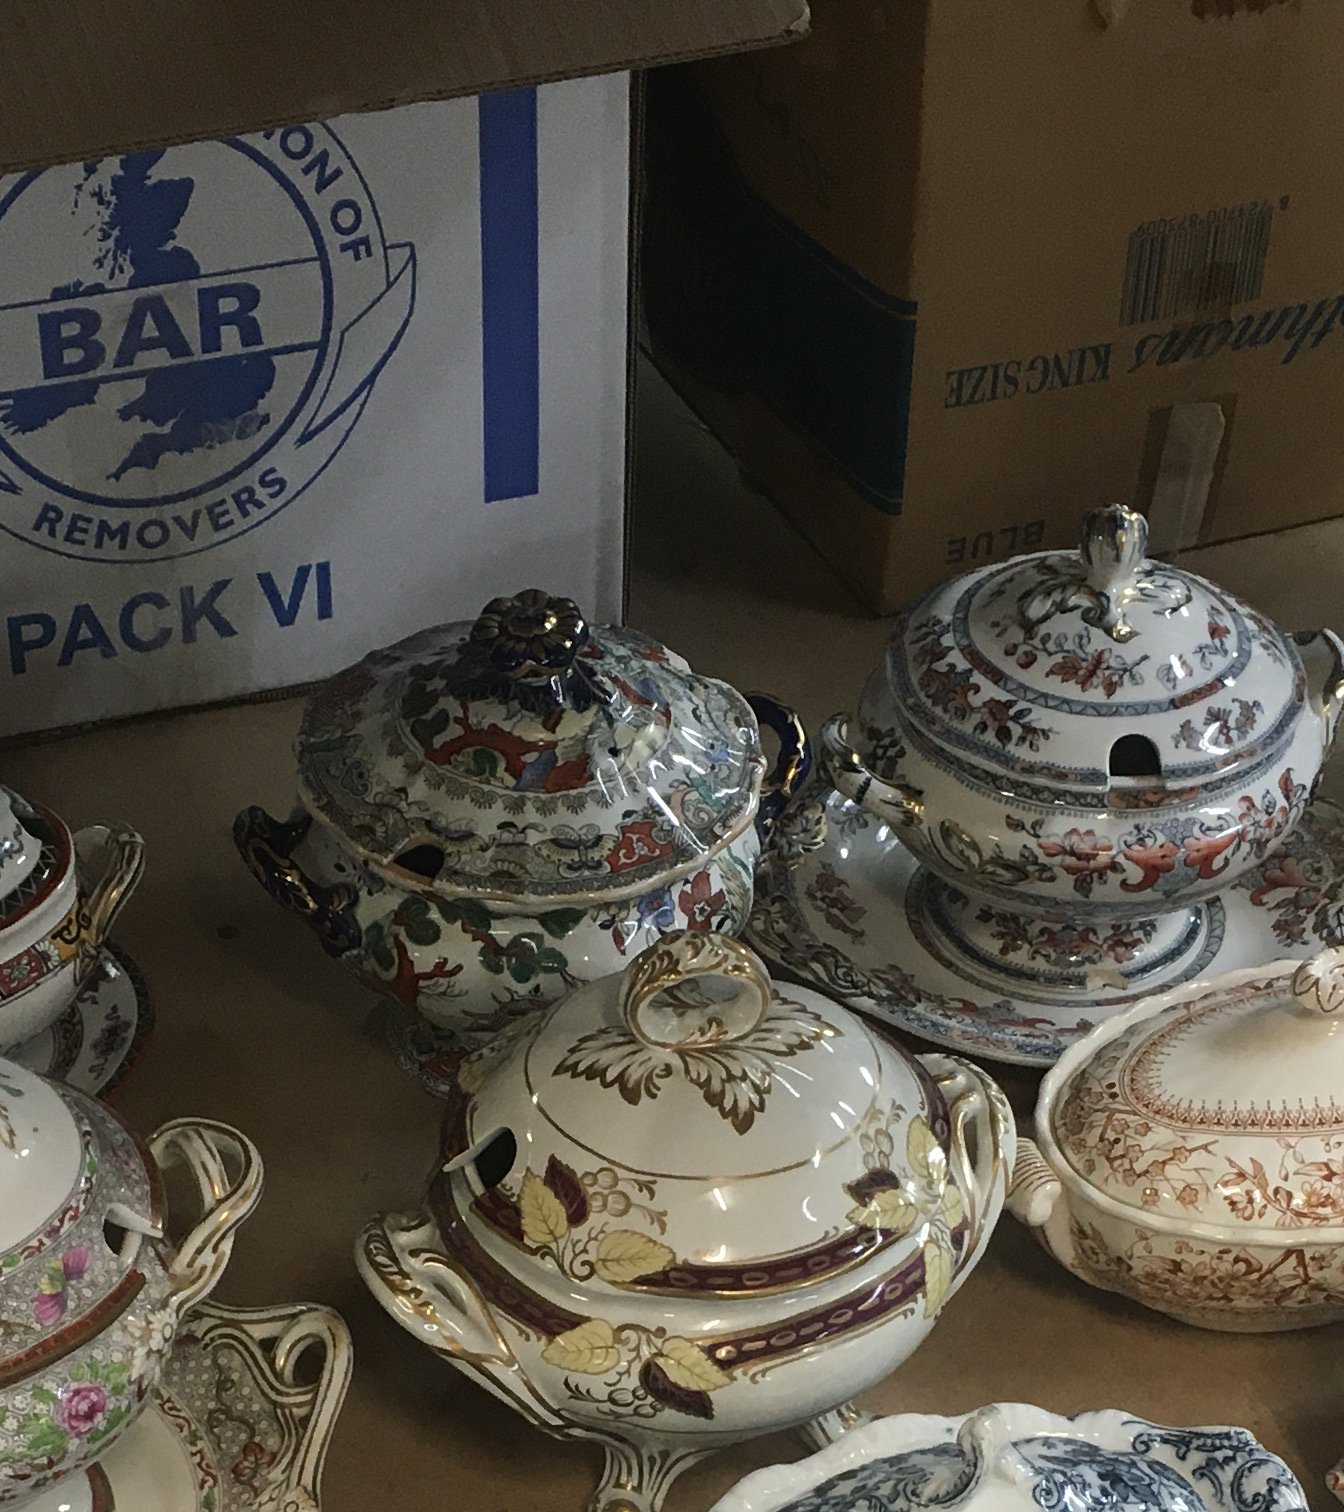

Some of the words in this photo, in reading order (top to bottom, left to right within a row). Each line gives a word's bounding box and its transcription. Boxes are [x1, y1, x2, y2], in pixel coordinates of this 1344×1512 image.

[330, 198, 373, 262] OF
[37, 281, 264, 380] BAR
[32, 466, 288, 551] REMOVERS
[945, 520, 1045, 565] BLUE
[6, 578, 238, 675] PACK
[257, 561, 333, 629] VI
